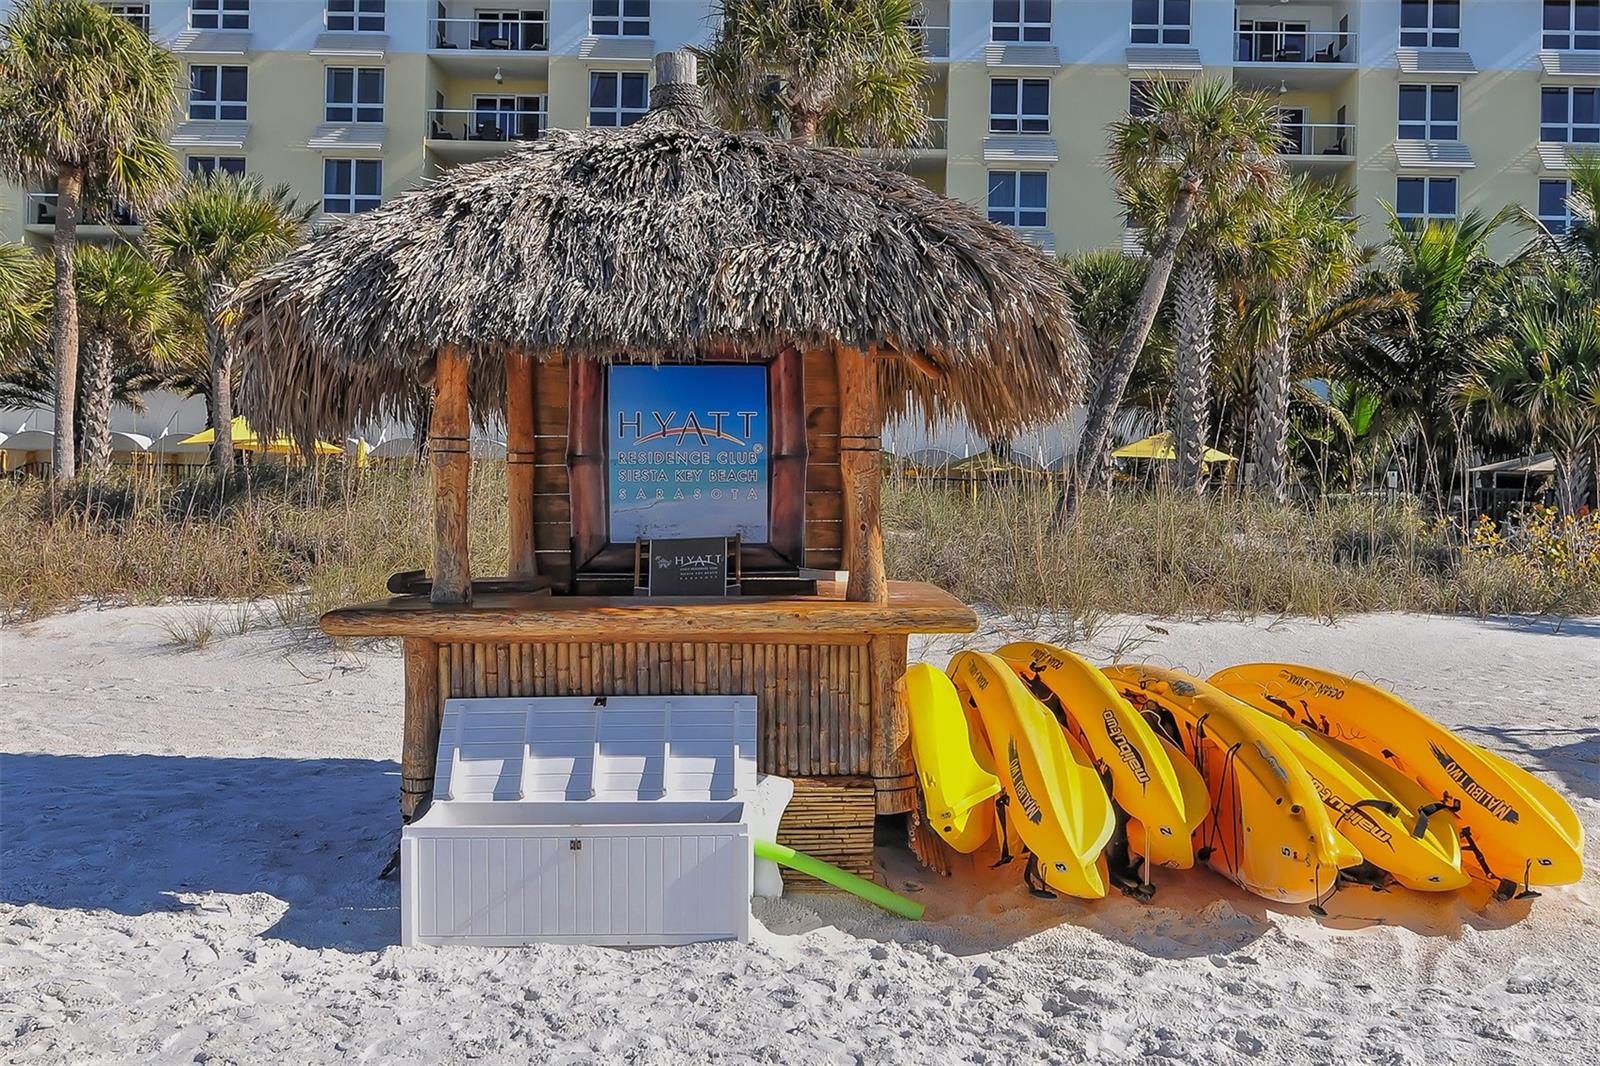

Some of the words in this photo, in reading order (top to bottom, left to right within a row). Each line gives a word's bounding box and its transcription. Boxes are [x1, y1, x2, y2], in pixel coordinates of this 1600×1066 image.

[618, 411, 758, 446] HYATT
[618, 451, 710, 465] RESIDENCE
[618, 469, 669, 482] SIESTA
[675, 469, 703, 482] KEY
[709, 469, 758, 482] BEACH
[618, 488, 758, 500] SARASOTA
[675, 554, 722, 567] HYATT
[1115, 734, 1151, 784] malibu
[1010, 758, 1023, 783] TWO
[1445, 761, 1469, 787] TWO
[1015, 780, 1041, 820] MALIBU
[1464, 782, 1513, 821] MALIBU
[1160, 826, 1173, 836] 2
[1055, 862, 1067, 872] 3
